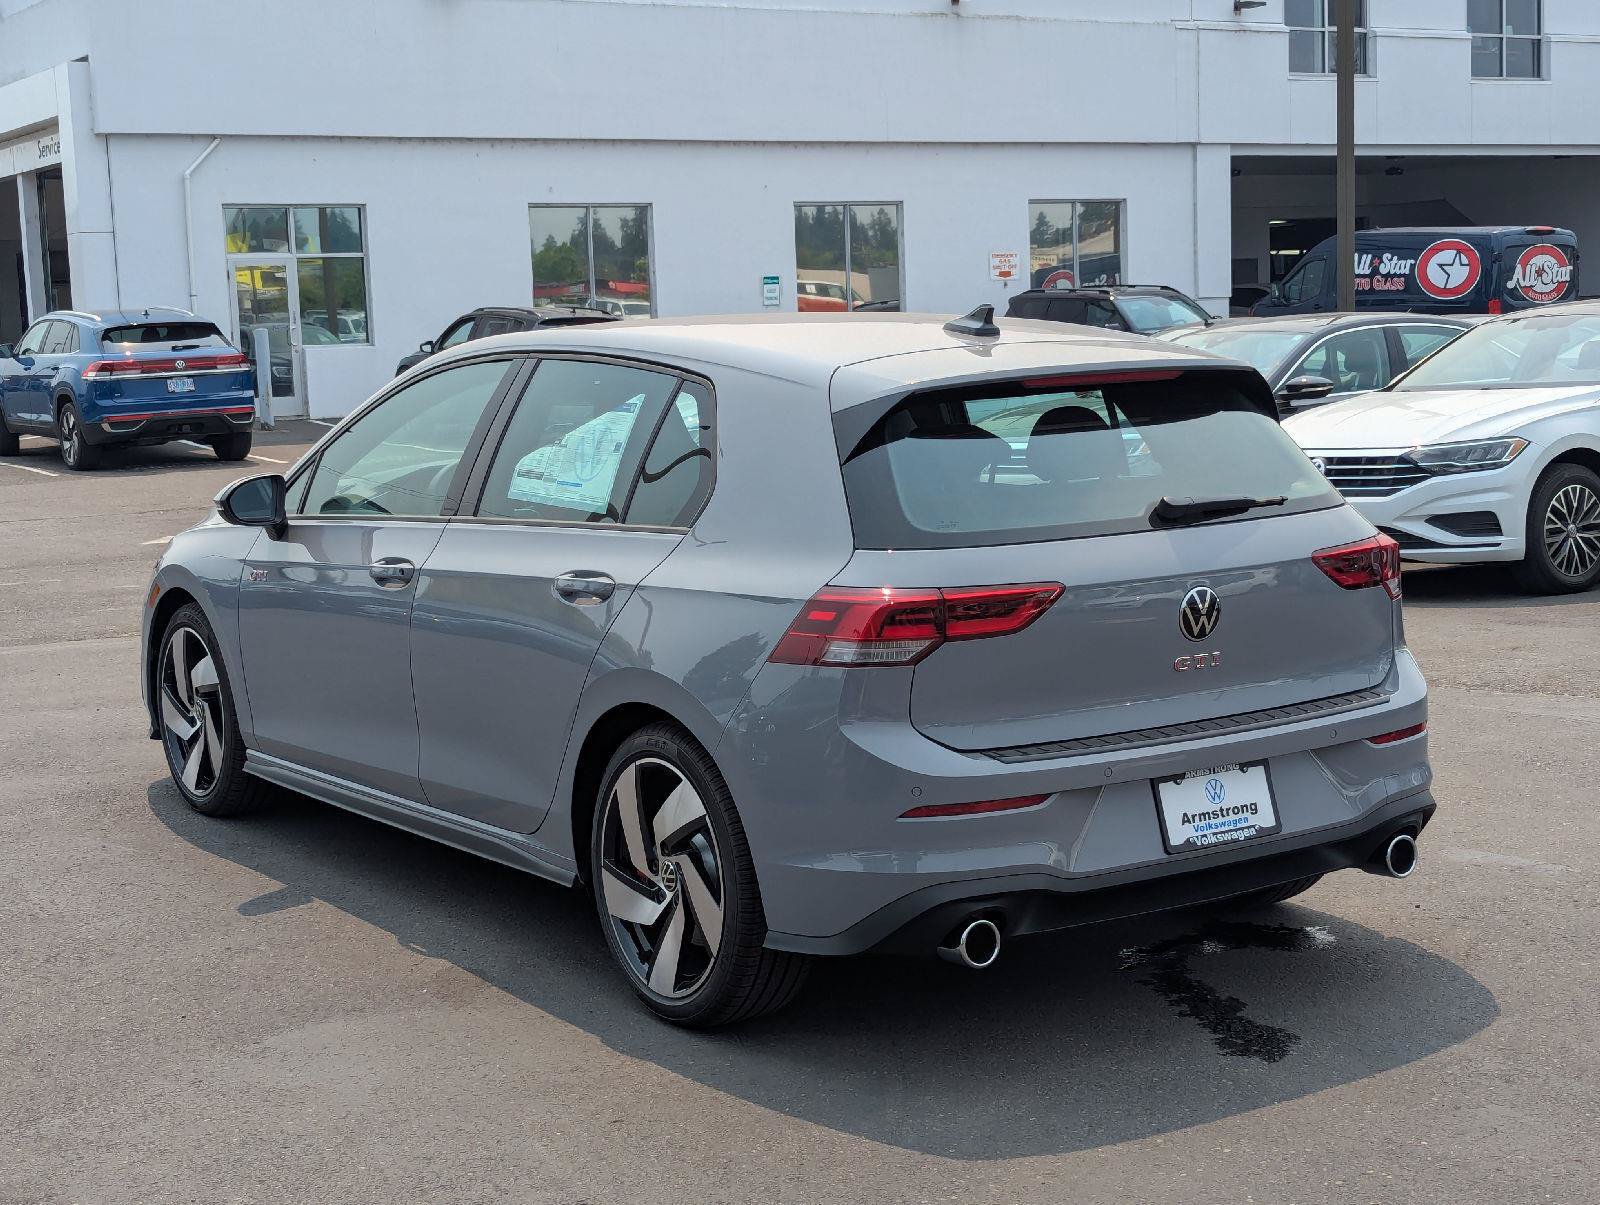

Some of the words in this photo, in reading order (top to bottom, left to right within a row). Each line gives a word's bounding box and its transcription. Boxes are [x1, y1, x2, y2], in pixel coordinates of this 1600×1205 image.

[37, 136, 61, 159] Service
[1379, 252, 1416, 275] Star
[1506, 263, 1537, 289] All
[1541, 260, 1574, 285] Star
[1174, 651, 1221, 672] GTI
[1184, 763, 1241, 779] ARMSTRONG
[1181, 802, 1258, 826] Armstrong
[1193, 816, 1249, 833] Volkswagen
[1193, 827, 1257, 846] Volkswagen
